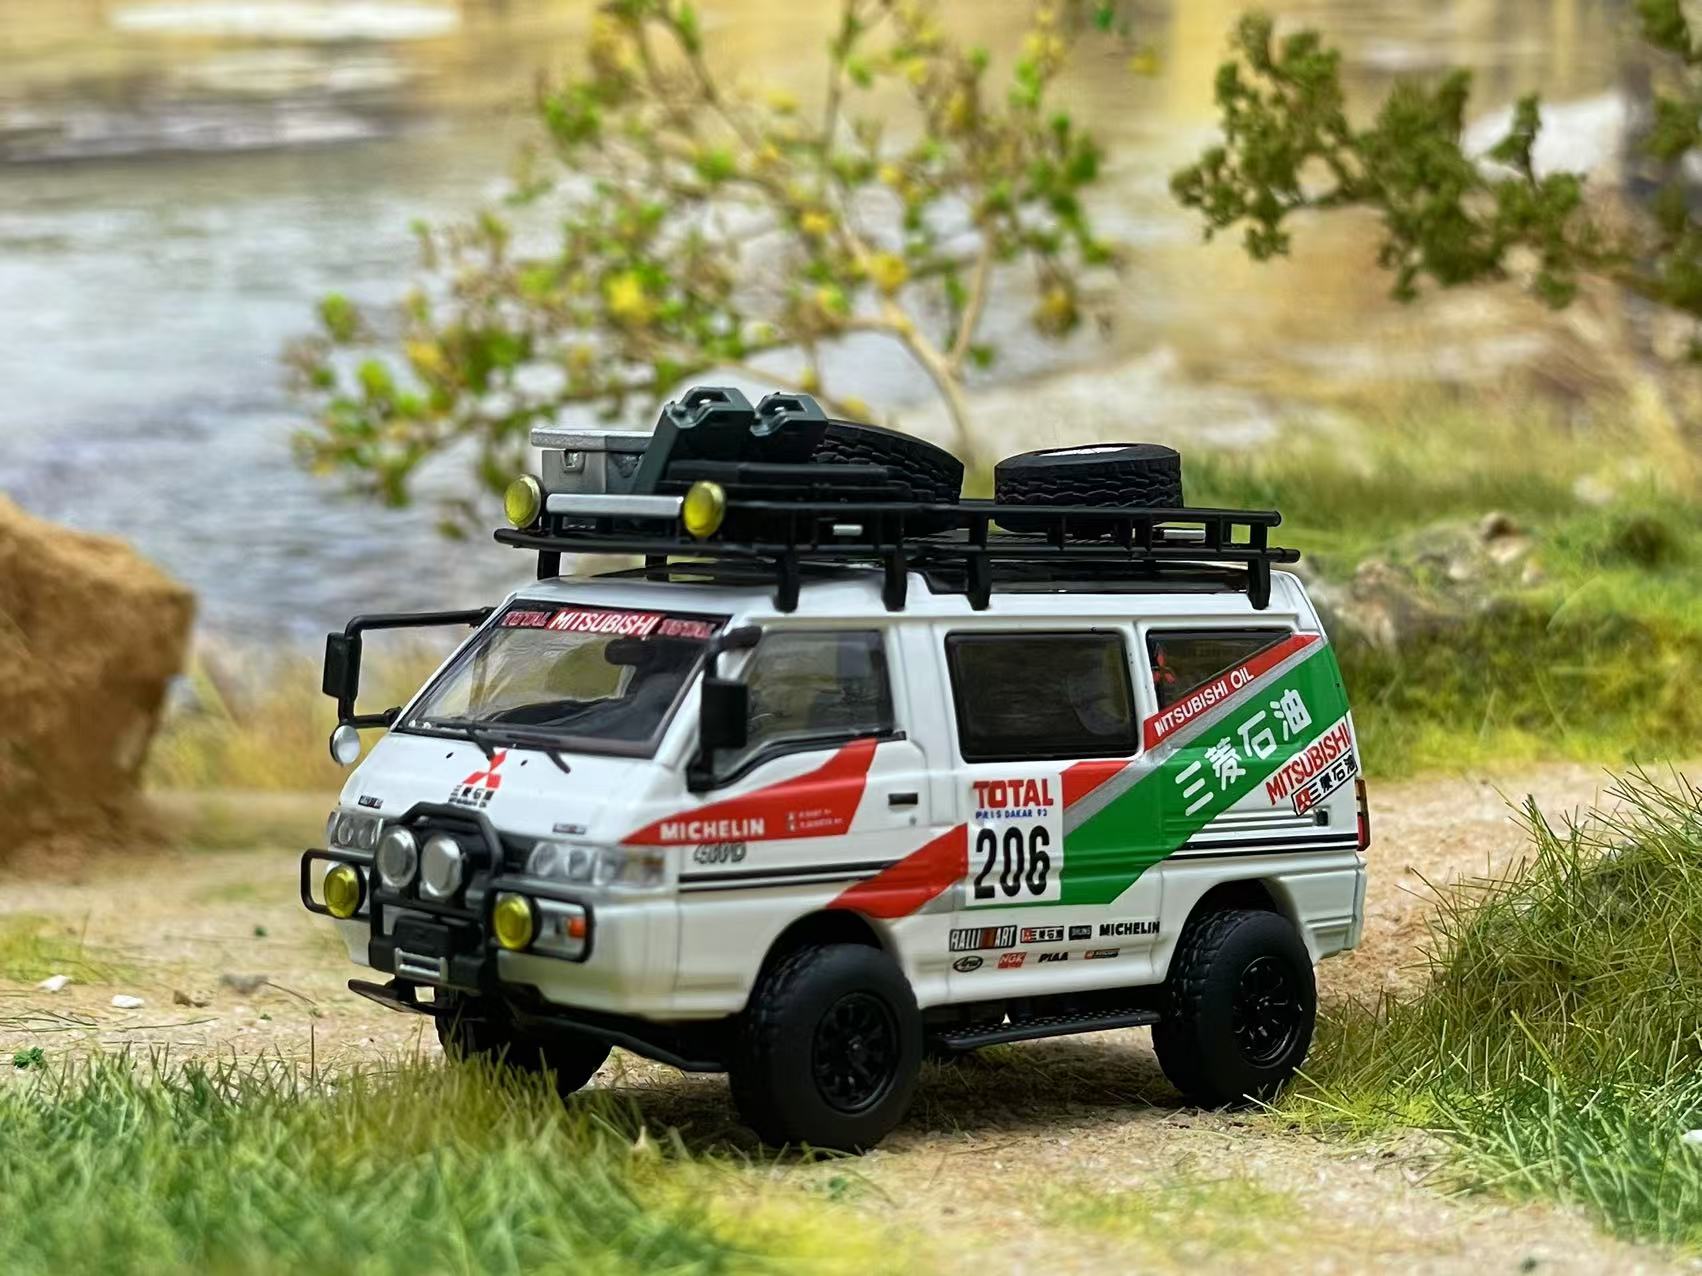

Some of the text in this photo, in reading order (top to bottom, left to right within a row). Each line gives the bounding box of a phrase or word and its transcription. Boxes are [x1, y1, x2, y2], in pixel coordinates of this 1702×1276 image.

[549, 611, 659, 635] MITSUBISHI
[1154, 667, 1254, 737] MITSUBISHI OIL
[1175, 689, 1312, 816] 三菱石油
[1265, 722, 1351, 805] MITSUBISHI
[973, 778, 1054, 809] TOTAL
[1005, 809, 1032, 818] DAKAR
[660, 818, 765, 841] MICHELIN
[974, 825, 1050, 900] 206
[1100, 921, 1160, 937] MICHELIN
